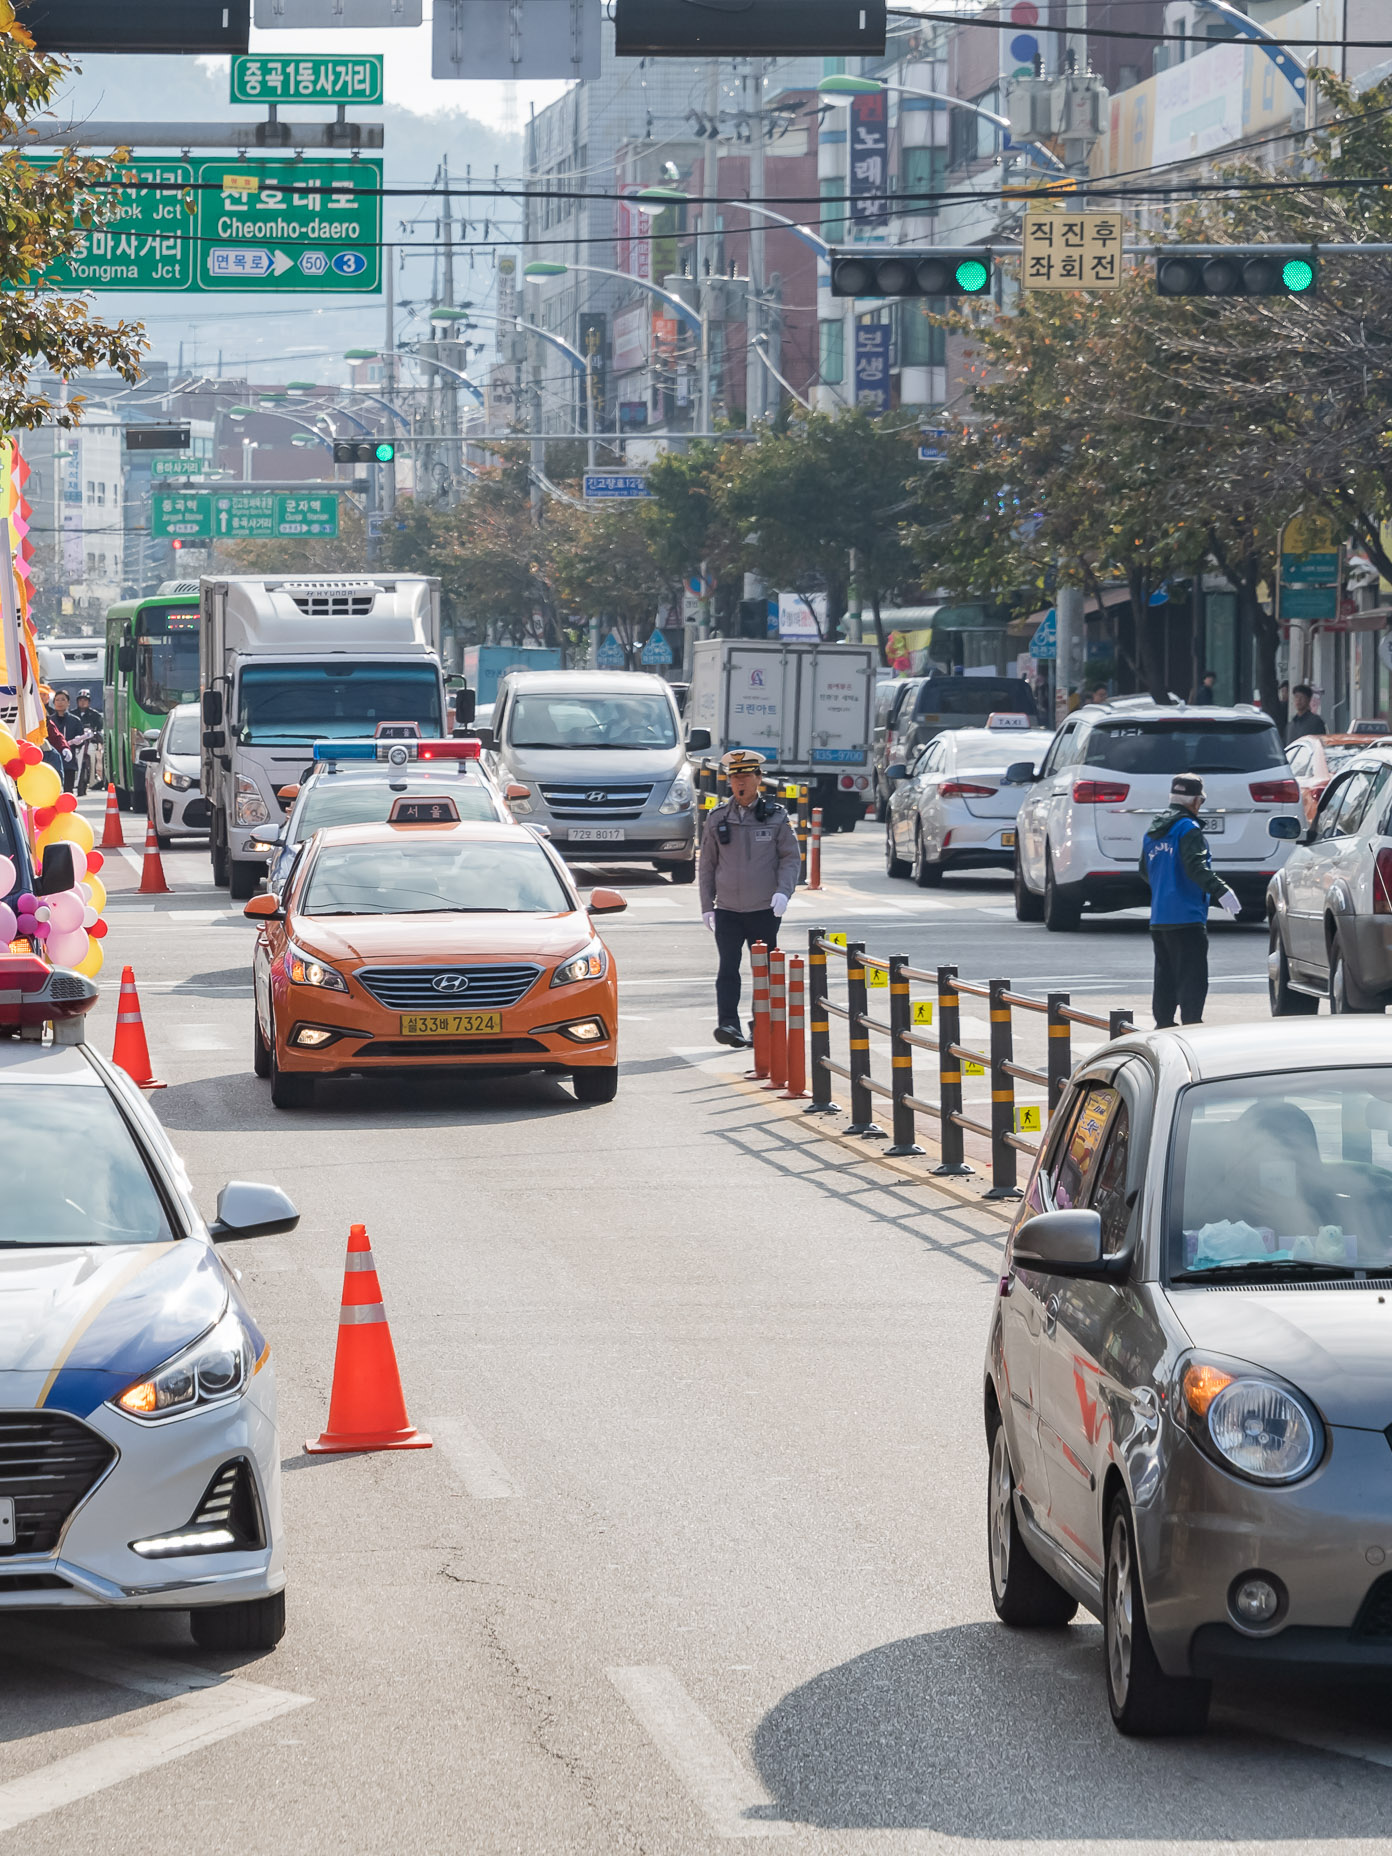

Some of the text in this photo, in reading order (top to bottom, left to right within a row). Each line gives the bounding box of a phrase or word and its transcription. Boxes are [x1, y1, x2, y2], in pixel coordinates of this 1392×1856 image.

[244, 61, 371, 96] 중곡1동사거리
[153, 203, 182, 220] Jct
[217, 216, 360, 239] Cheonho-daero
[1030, 221, 1117, 248] 직진후
[152, 262, 181, 279] Jct
[216, 254, 264, 270] 면목로
[305, 256, 322, 270] 50
[342, 254, 356, 272] 3
[1029, 254, 1116, 280] 좌회전
[285, 499, 321, 512] 군자역
[385, 728, 411, 737] 서울
[407, 805, 443, 819] 서울
[596, 830, 620, 839] 8017
[453, 1015, 495, 1032] 7324
